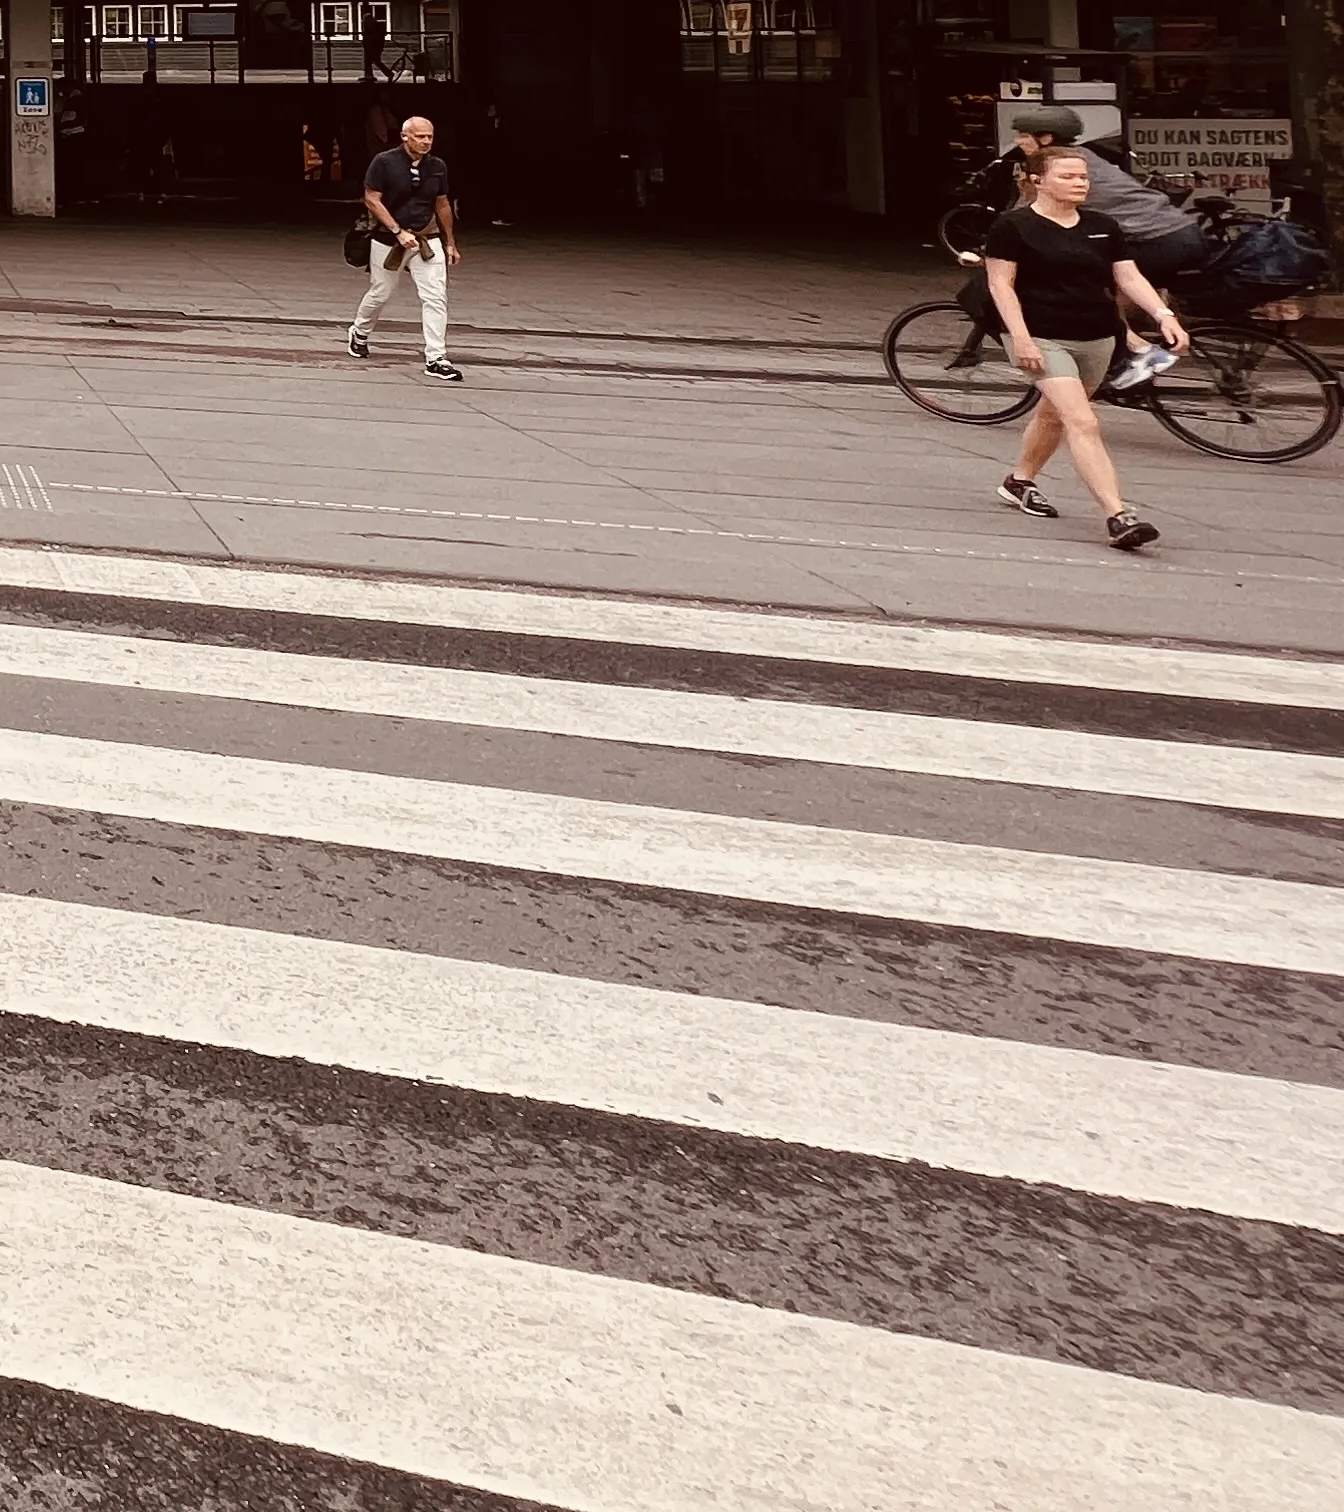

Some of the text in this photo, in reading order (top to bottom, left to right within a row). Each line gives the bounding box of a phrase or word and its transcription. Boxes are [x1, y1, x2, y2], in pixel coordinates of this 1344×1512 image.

[1135, 129, 1289, 146] DU KAN SAGTENS
